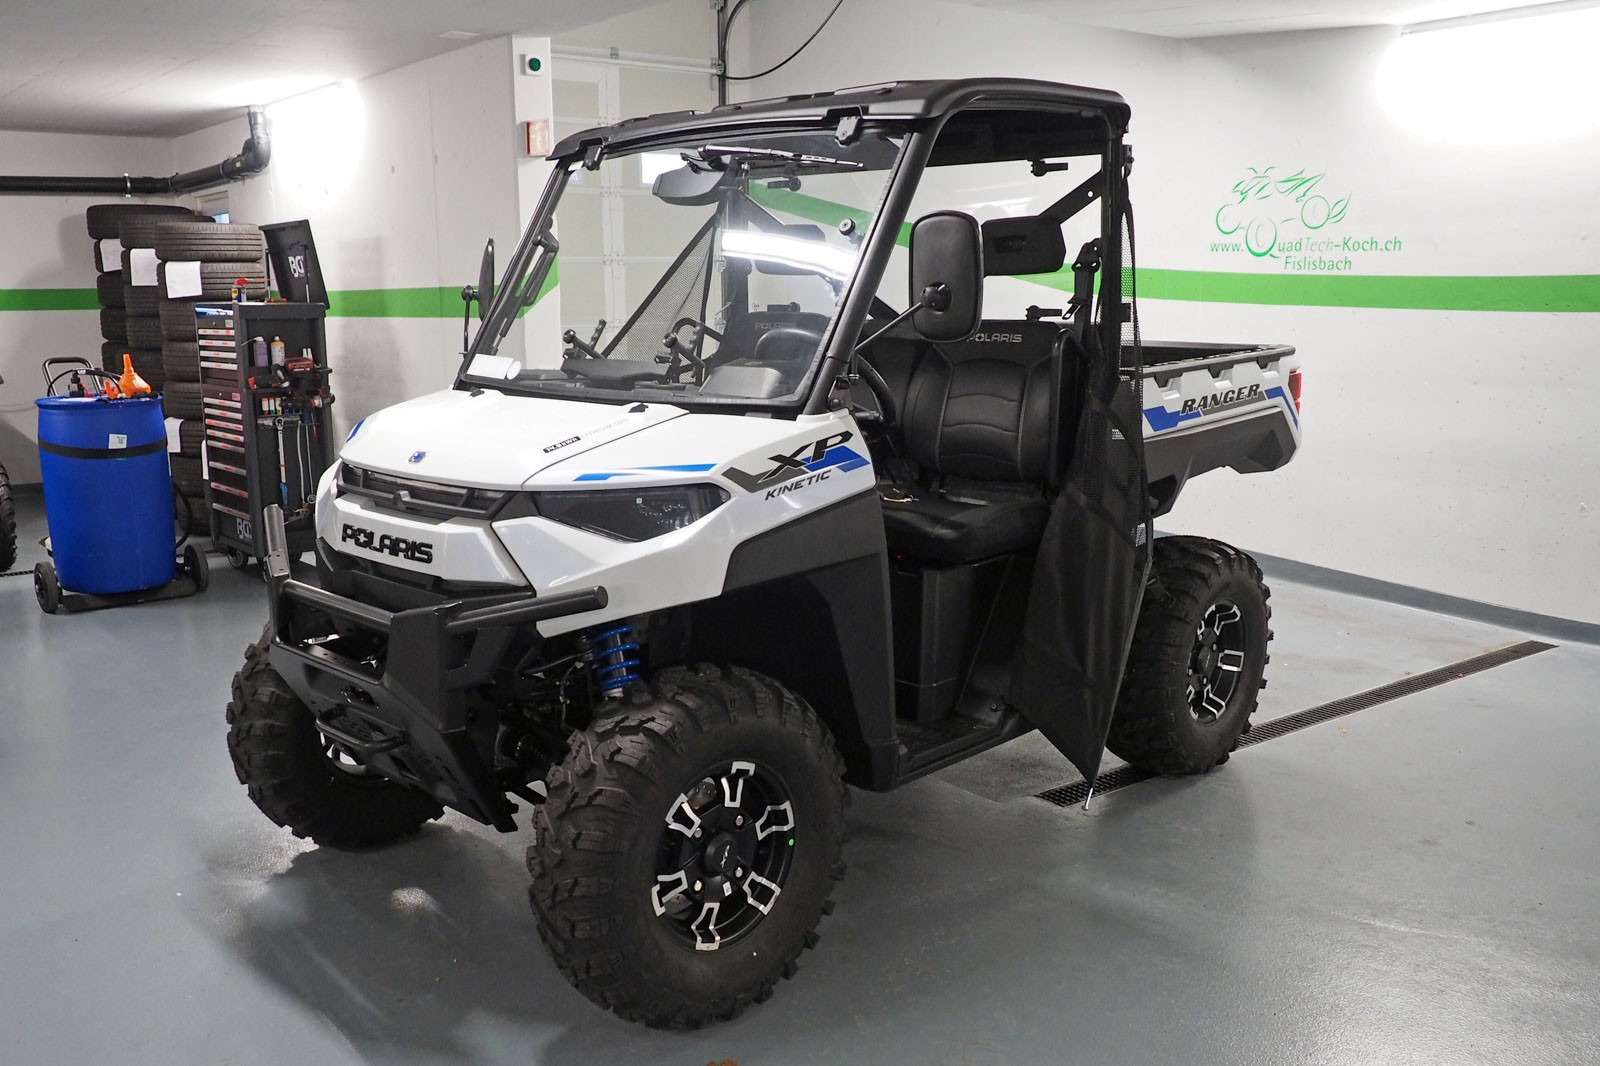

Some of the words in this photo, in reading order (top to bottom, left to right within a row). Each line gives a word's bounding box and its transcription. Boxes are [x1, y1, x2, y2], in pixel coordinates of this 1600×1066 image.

[1284, 255, 1352, 271] Fislisbach
[1180, 383, 1260, 415] RANGER
[761, 430, 854, 481] XP
[764, 469, 832, 501] KINETIC
[341, 522, 433, 565] POLARIS
